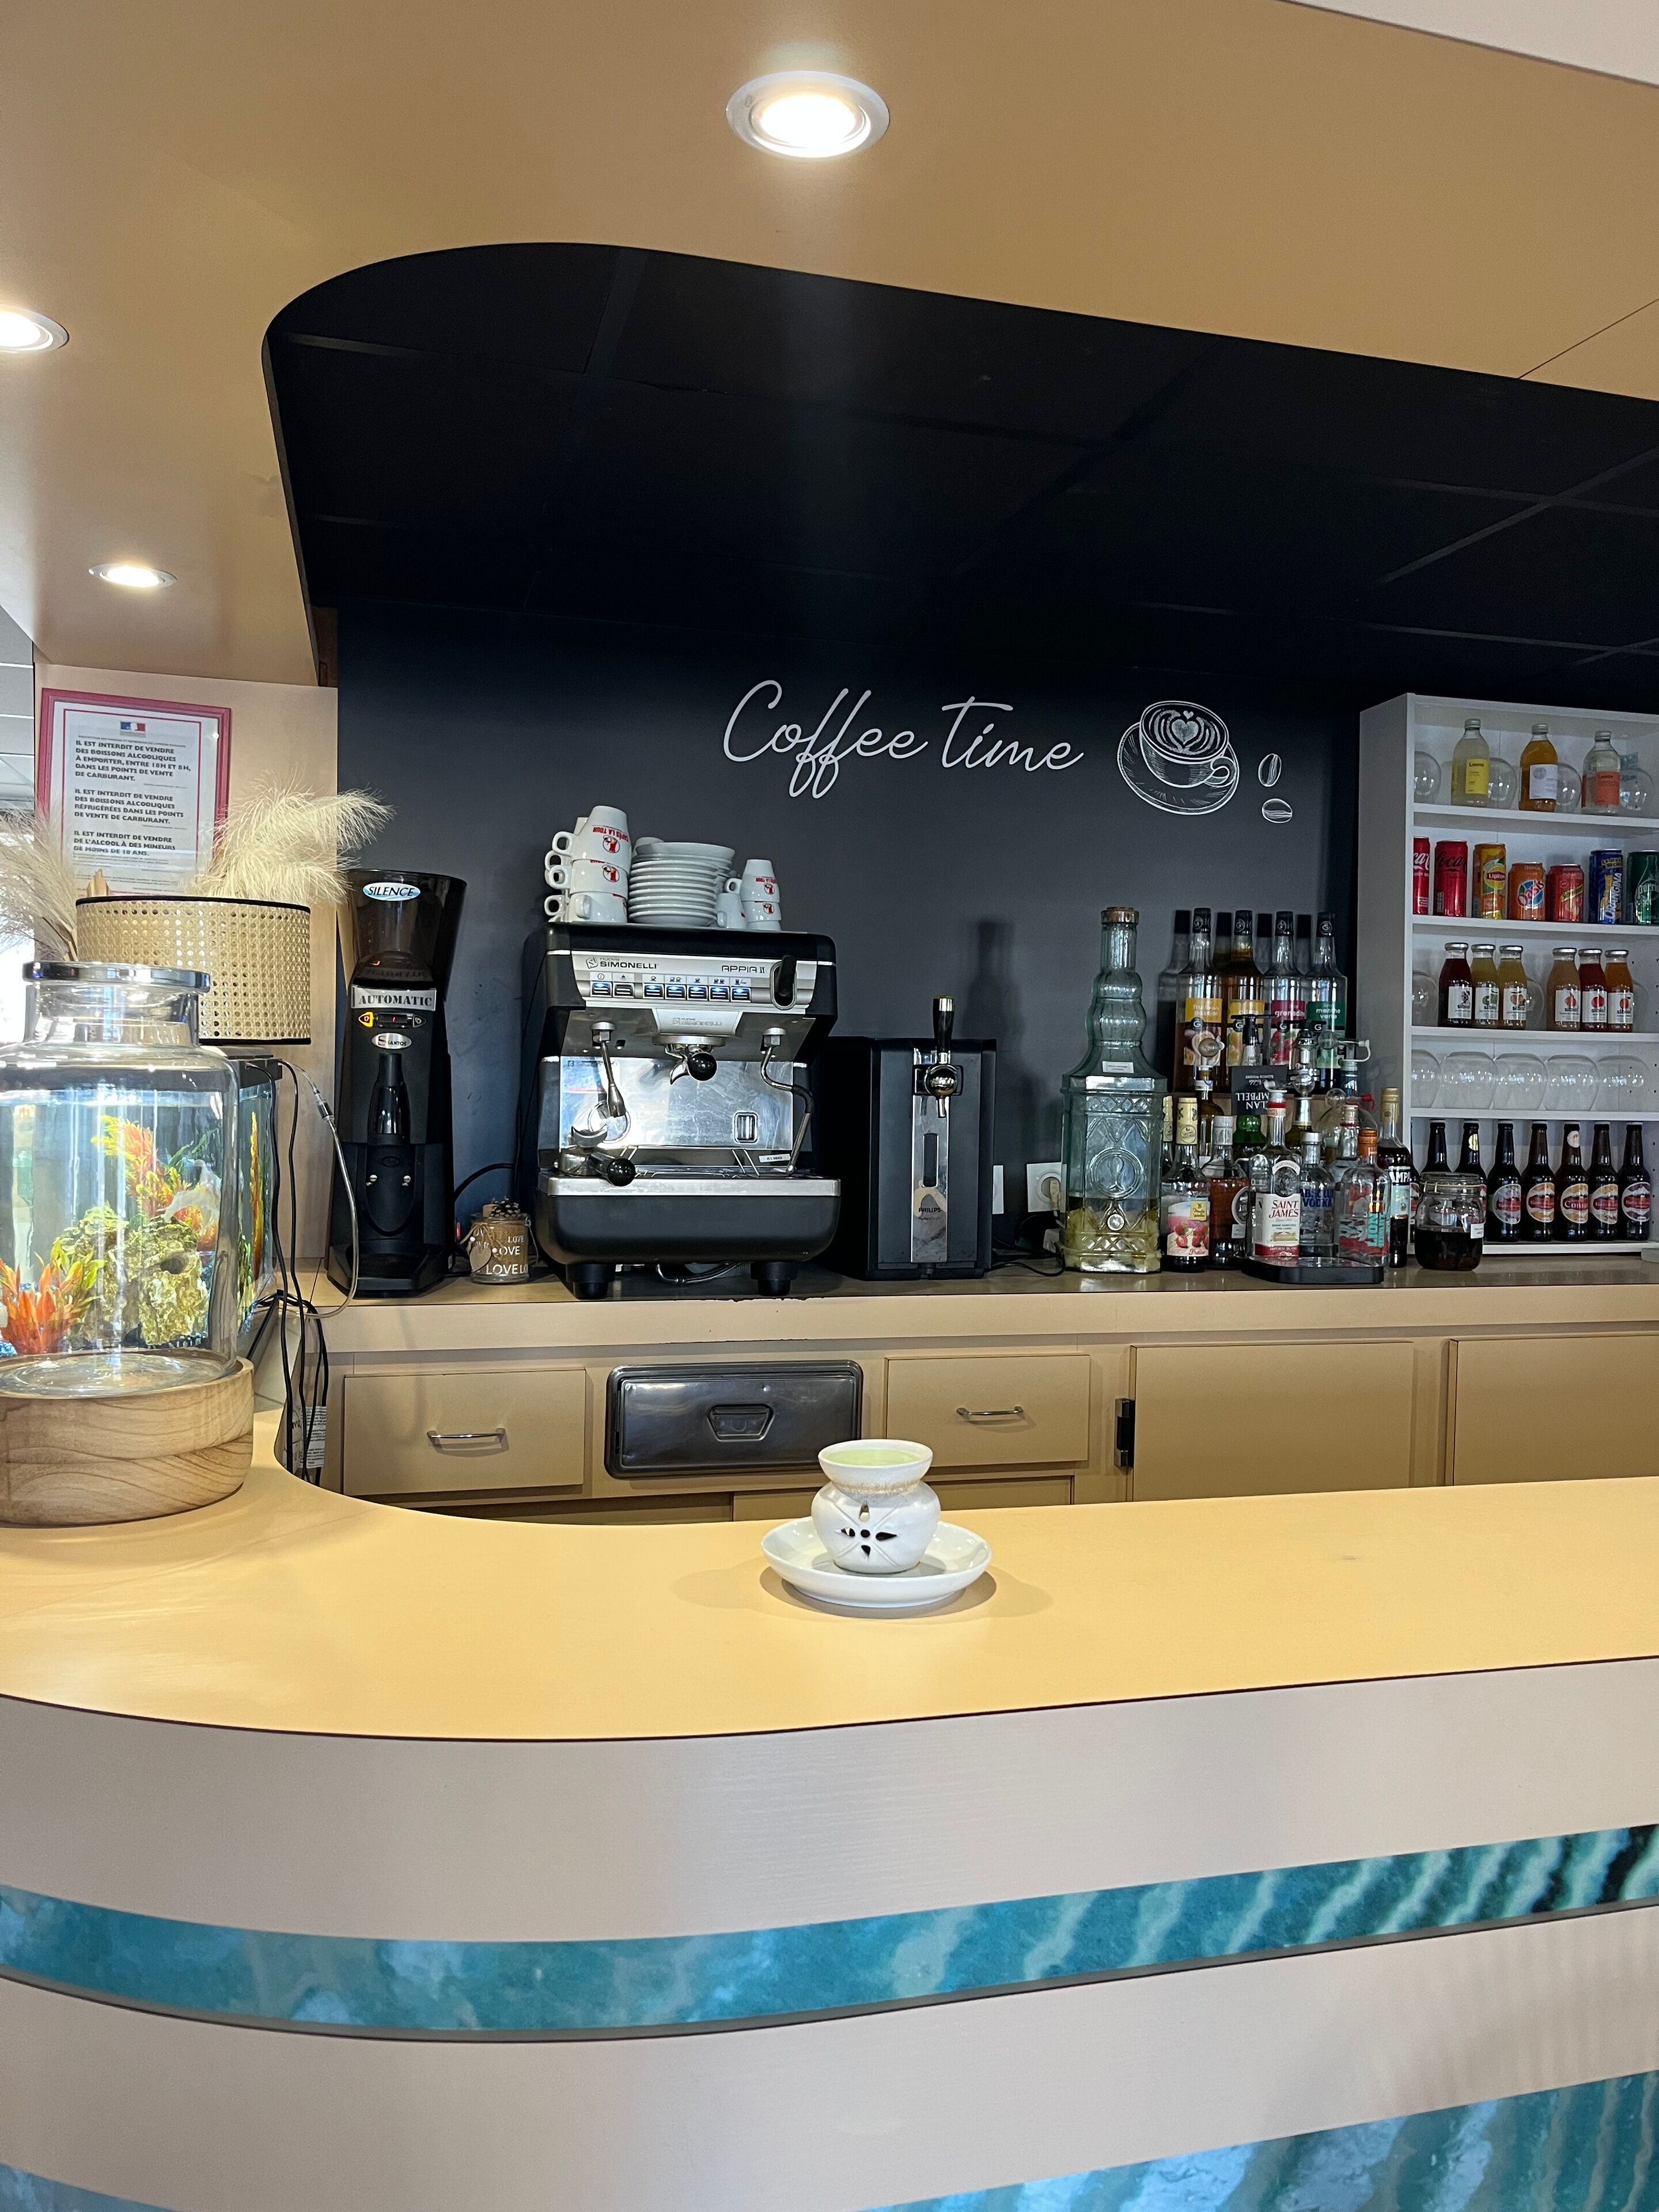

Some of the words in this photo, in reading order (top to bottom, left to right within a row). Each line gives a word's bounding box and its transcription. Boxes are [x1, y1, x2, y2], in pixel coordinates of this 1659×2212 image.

[722, 680, 929, 799] Coffee
[99, 742, 132, 750] INTERDIT
[90, 749, 126, 757] BOISSONS
[127, 752, 176, 762] ALCOOLIQUES
[83, 756, 124, 766] EMPORTER,
[126, 800, 175, 809] ALCOOLIQUES
[122, 816, 171, 824] CARBURANT.
[367, 886, 415, 897] SILENCE
[600, 961, 657, 969] SIMONELLI
[721, 965, 757, 973] APPIA
[358, 995, 433, 1007] AUTOMATIC
[1235, 1092, 1270, 1101] MPBELL
[1246, 1101, 1268, 1110] LAN
[1272, 1200, 1299, 1209] SAINT
[1269, 1210, 1299, 1218] JAMES
[507, 1236, 524, 1244] LOVE
[486, 1263, 518, 1275] LOVE
